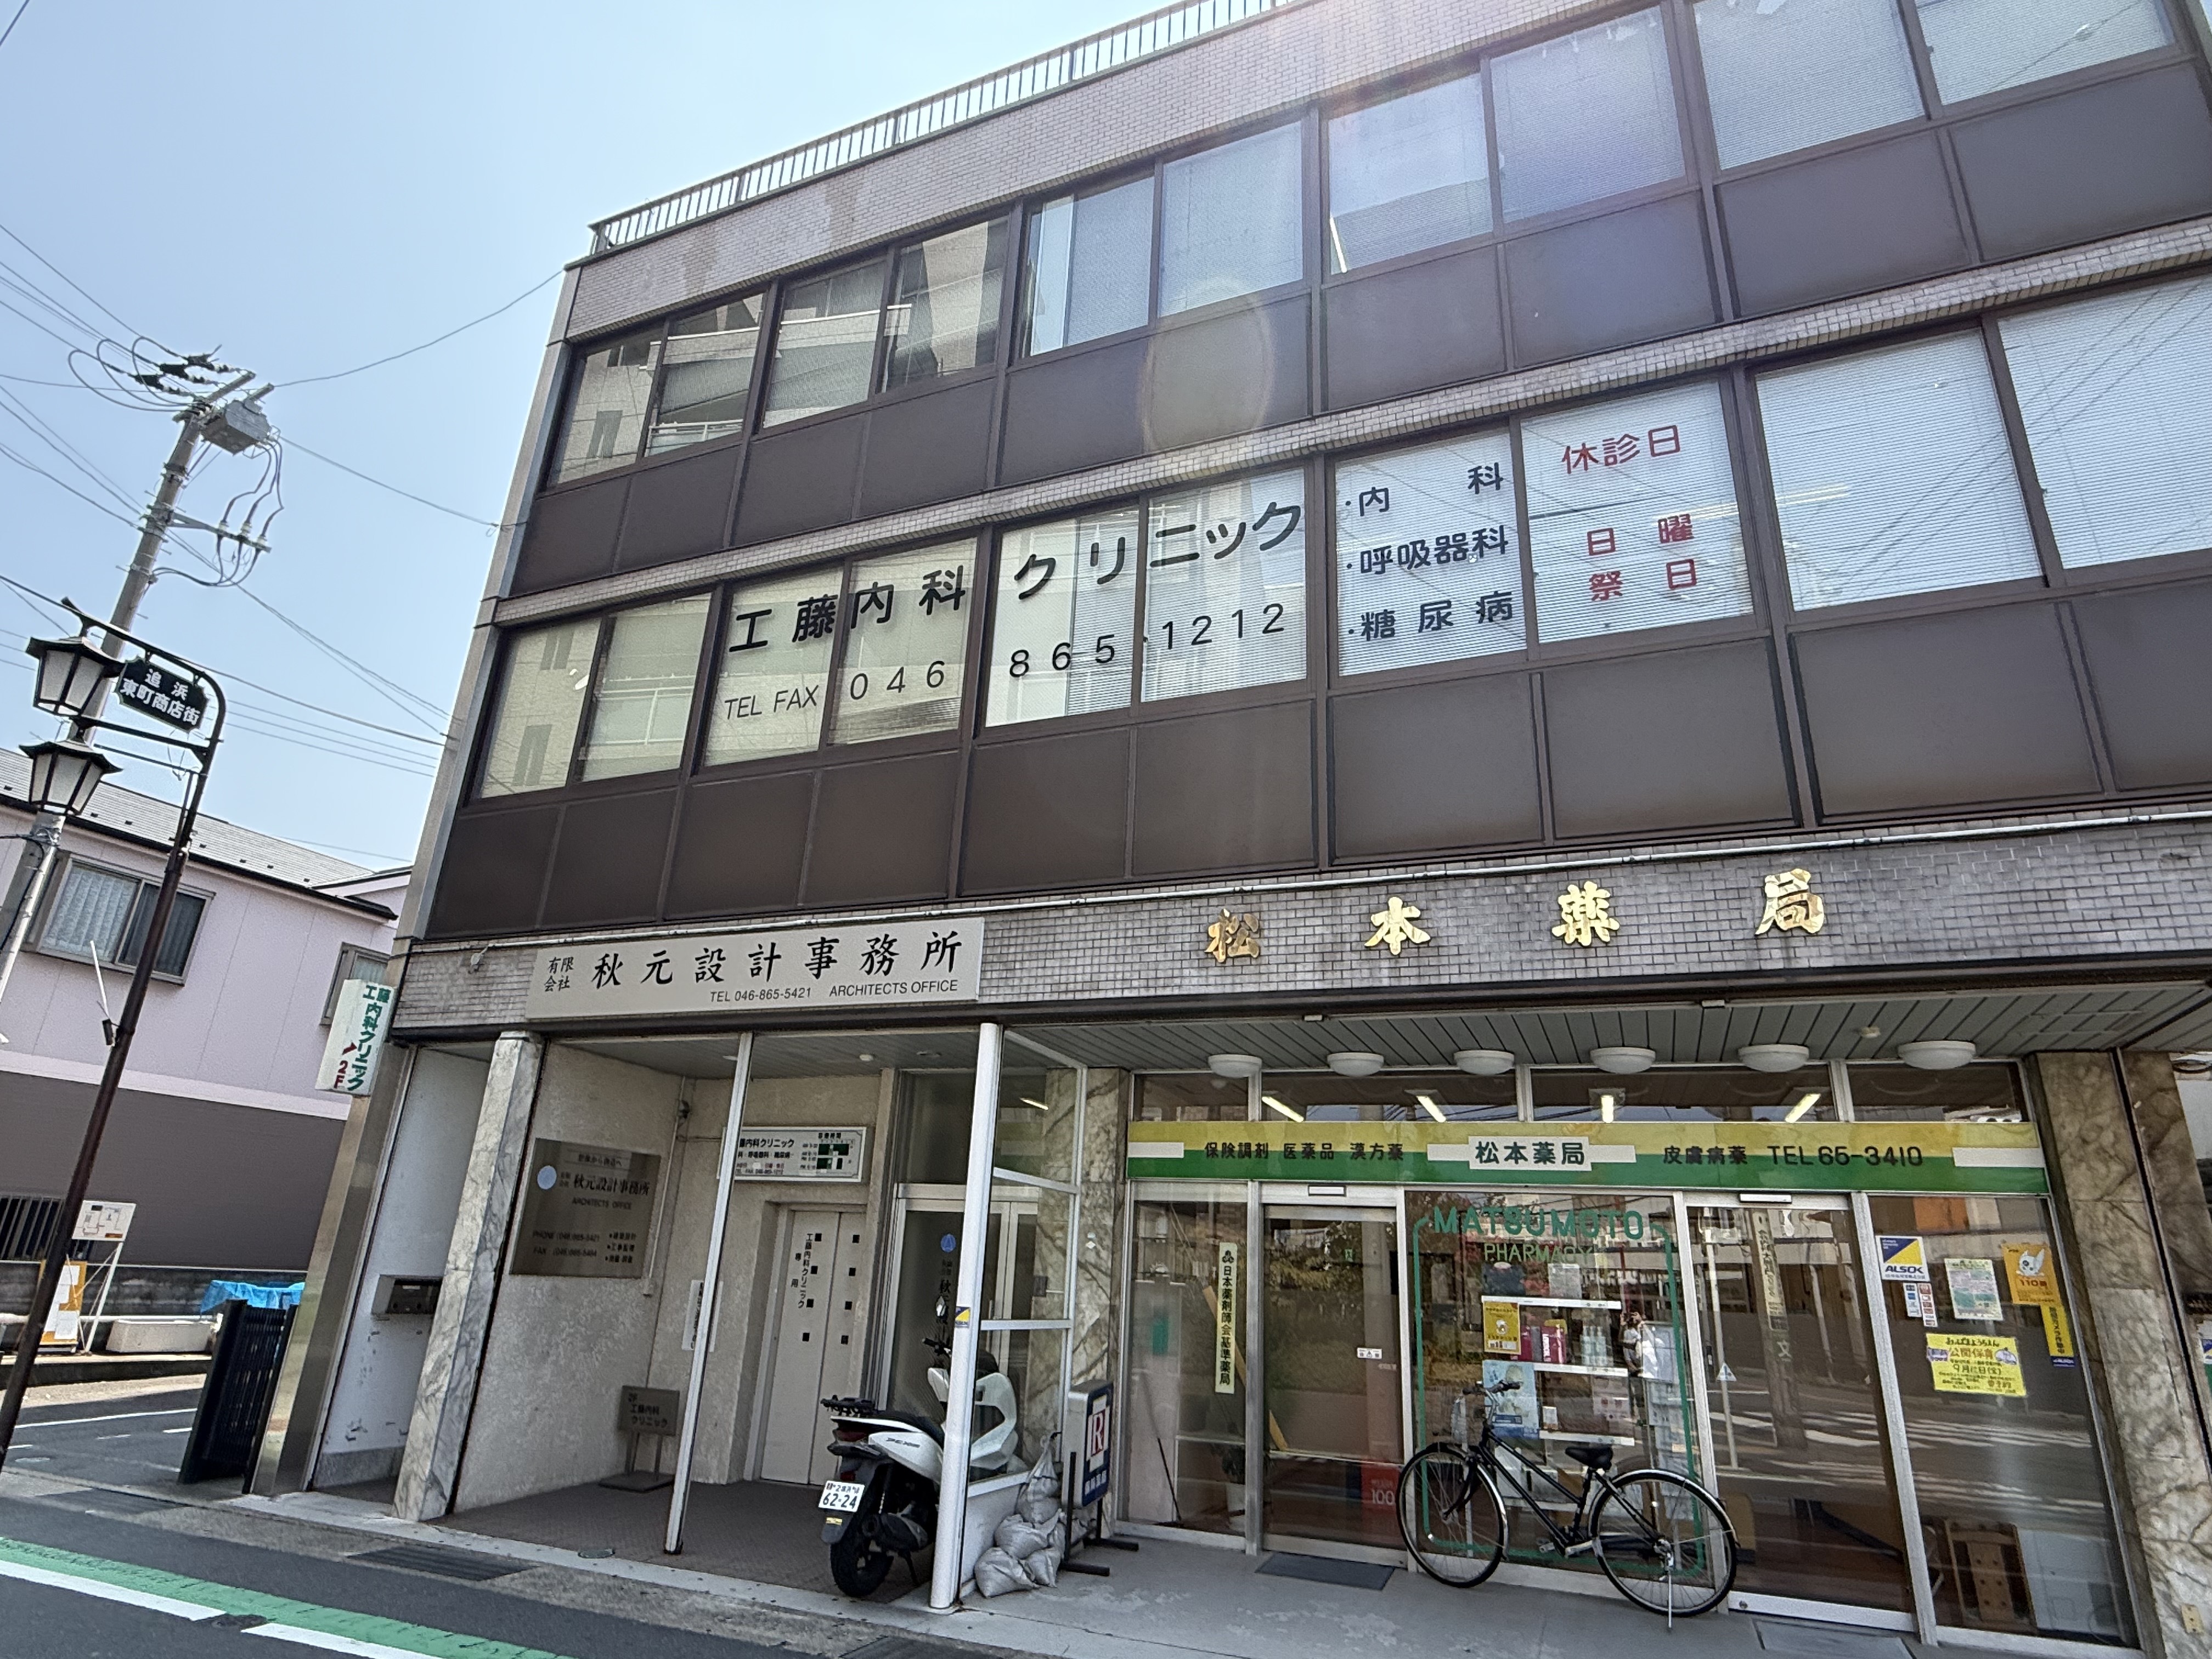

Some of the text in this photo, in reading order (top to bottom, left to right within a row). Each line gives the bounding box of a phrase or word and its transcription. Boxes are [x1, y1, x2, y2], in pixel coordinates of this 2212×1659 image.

[1562, 425, 1680, 473] 休診日
[1359, 462, 1503, 516] 内科
[1360, 524, 1508, 574] 呼吸器科
[1587, 514, 1694, 555] 日曜
[1589, 558, 1697, 601] 祭日
[1361, 591, 1513, 641] 糖尿病
[120, 678, 201, 725] 東町商店街
[145, 668, 188, 701] 追浜
[725, 695, 762, 719] TEL
[774, 685, 819, 712] FAX
[591, 930, 962, 989] 秋元設計事務所
[710, 980, 958, 1002] TEL 046-865-5421 ARCHITECTS OFFICE
[347, 1002, 382, 1091] 内科クリニック
[334, 1060, 348, 1088] 2F
[1205, 1142, 1404, 1161] 保険調剤 医薬品 漢方薬
[1475, 1141, 1584, 1165] 松本薬局
[1767, 1146, 1813, 1165] TEL
[1818, 1146, 1923, 1166] 65-3410
[1434, 1206, 1644, 1240] MATSUMOTO
[1485, 1243, 1592, 1262] PHARMACY
[1885, 1265, 1925, 1274] ALSOK
[1219, 1266, 1233, 1386] 日本薬剤師会基準薬局
